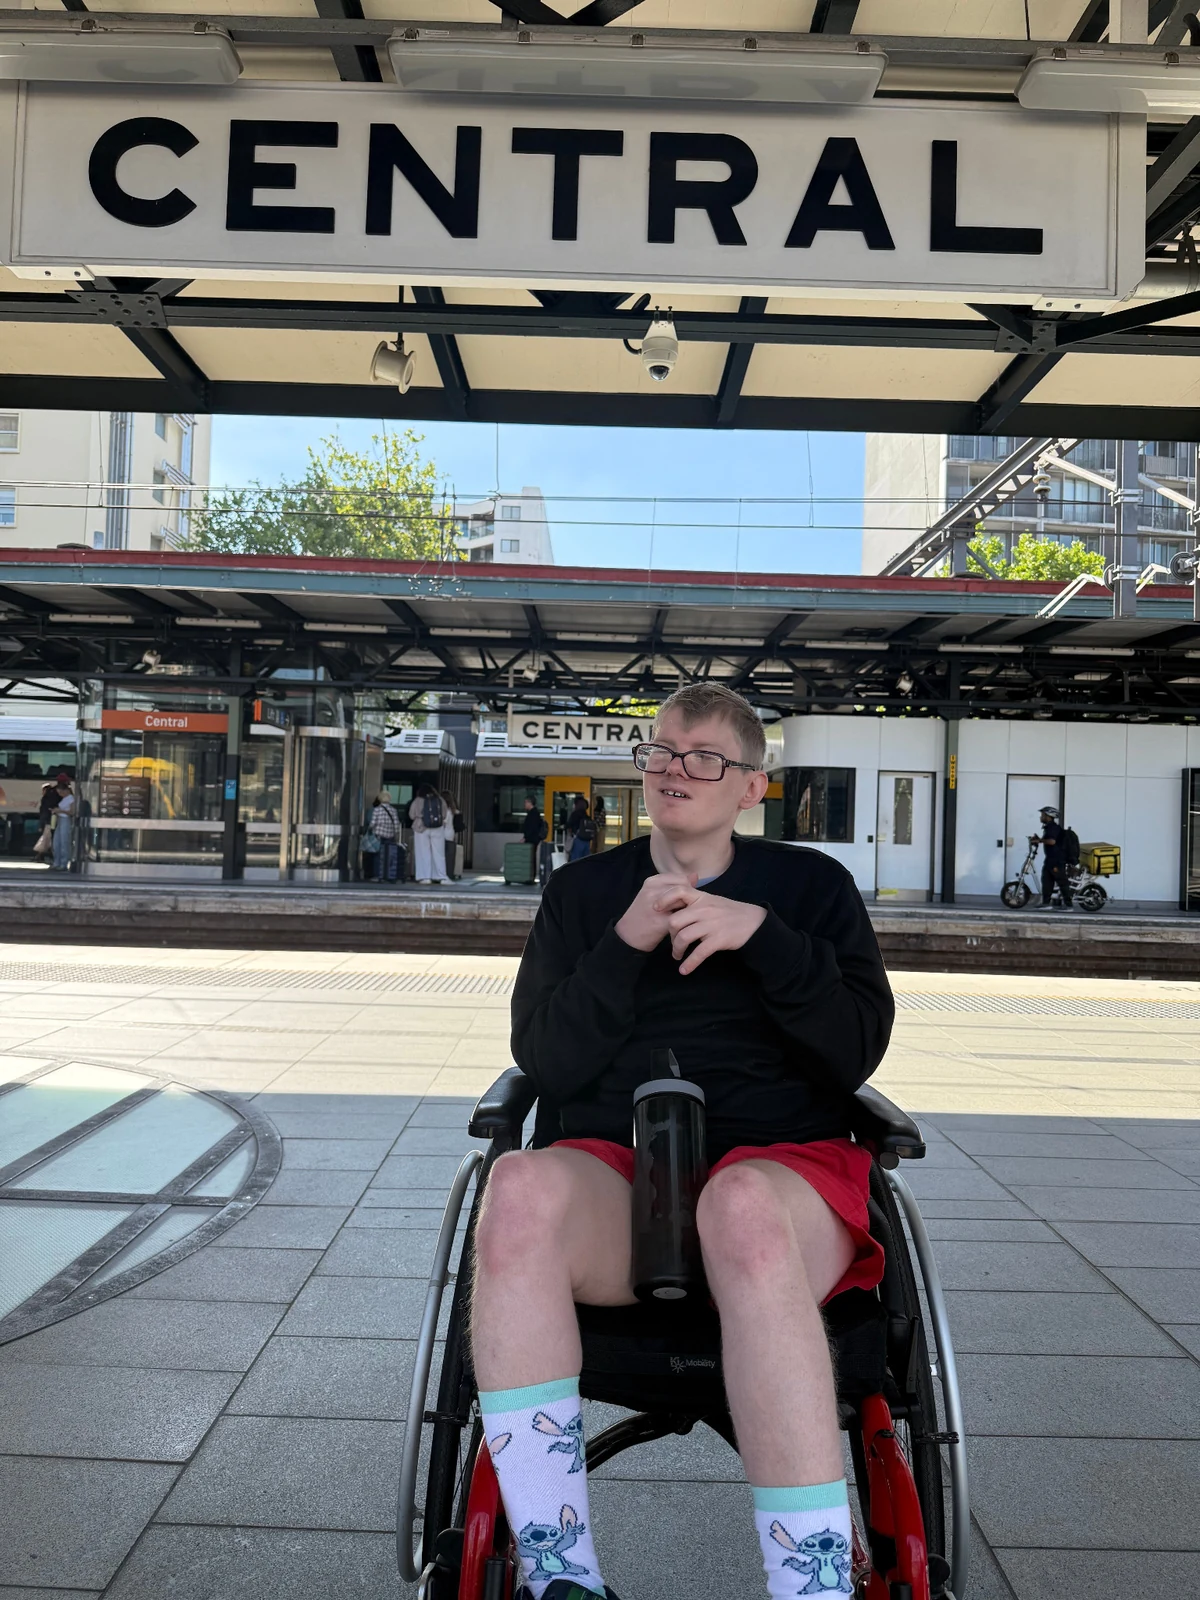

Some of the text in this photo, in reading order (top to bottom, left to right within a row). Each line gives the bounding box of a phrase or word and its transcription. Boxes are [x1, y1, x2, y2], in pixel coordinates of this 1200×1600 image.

[88, 116, 1044, 255] CENTRAL
[145, 715, 188, 728] Central
[522, 721, 654, 742] CENTRA
[686, 1359, 716, 1369] Mobility
